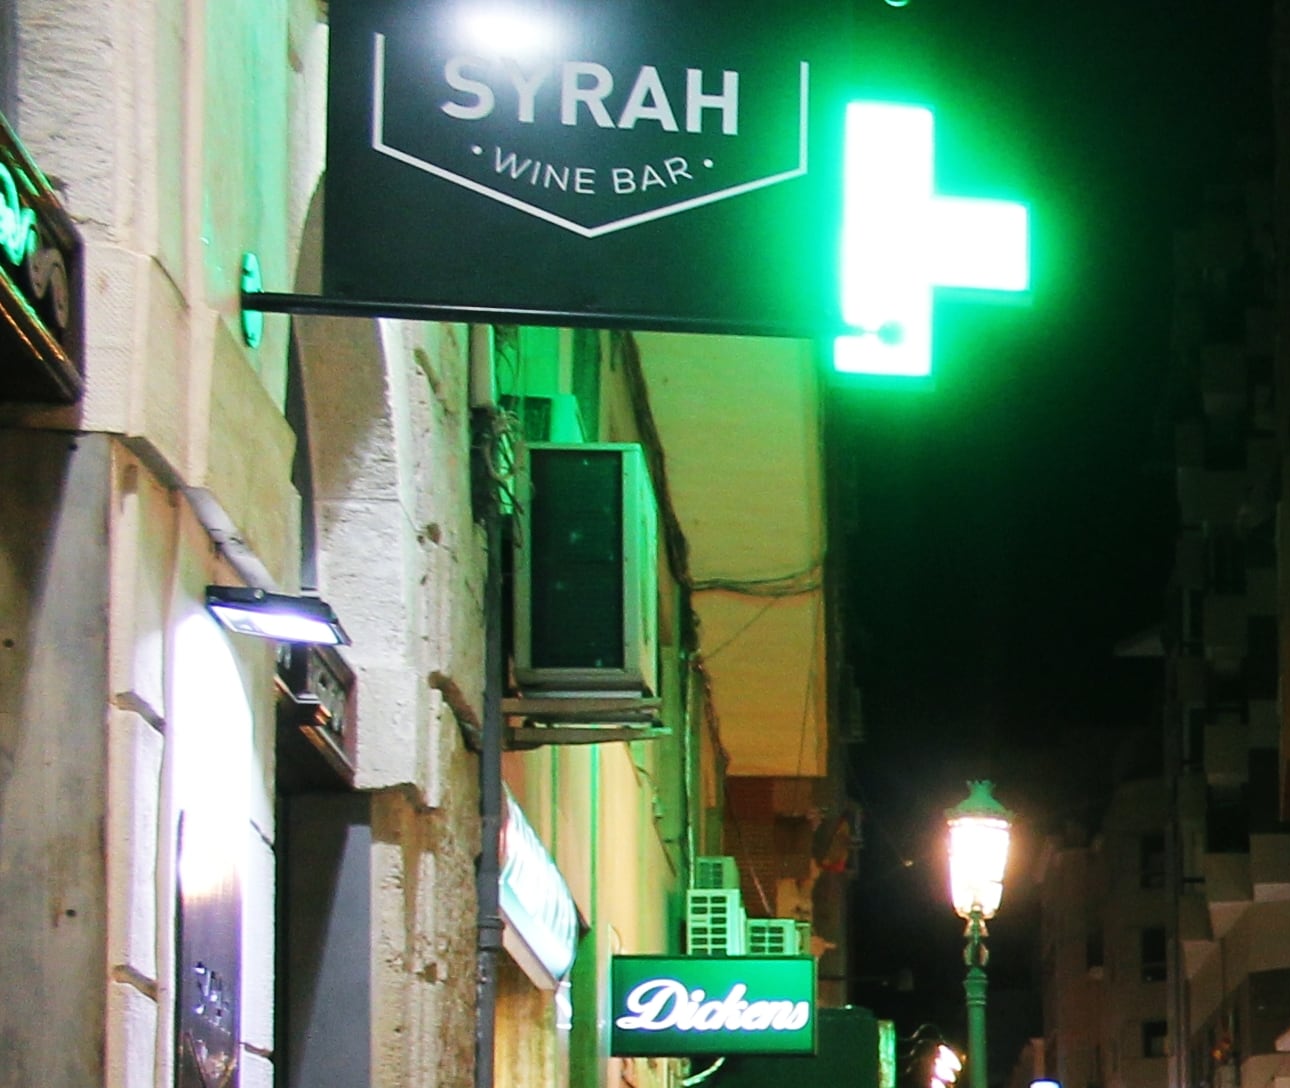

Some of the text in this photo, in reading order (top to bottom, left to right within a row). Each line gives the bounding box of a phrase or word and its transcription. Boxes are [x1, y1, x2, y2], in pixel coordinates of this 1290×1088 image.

[441, 55, 739, 135] SYRAH
[493, 146, 694, 194] WINE BAR
[615, 978, 810, 1031] Dickens
